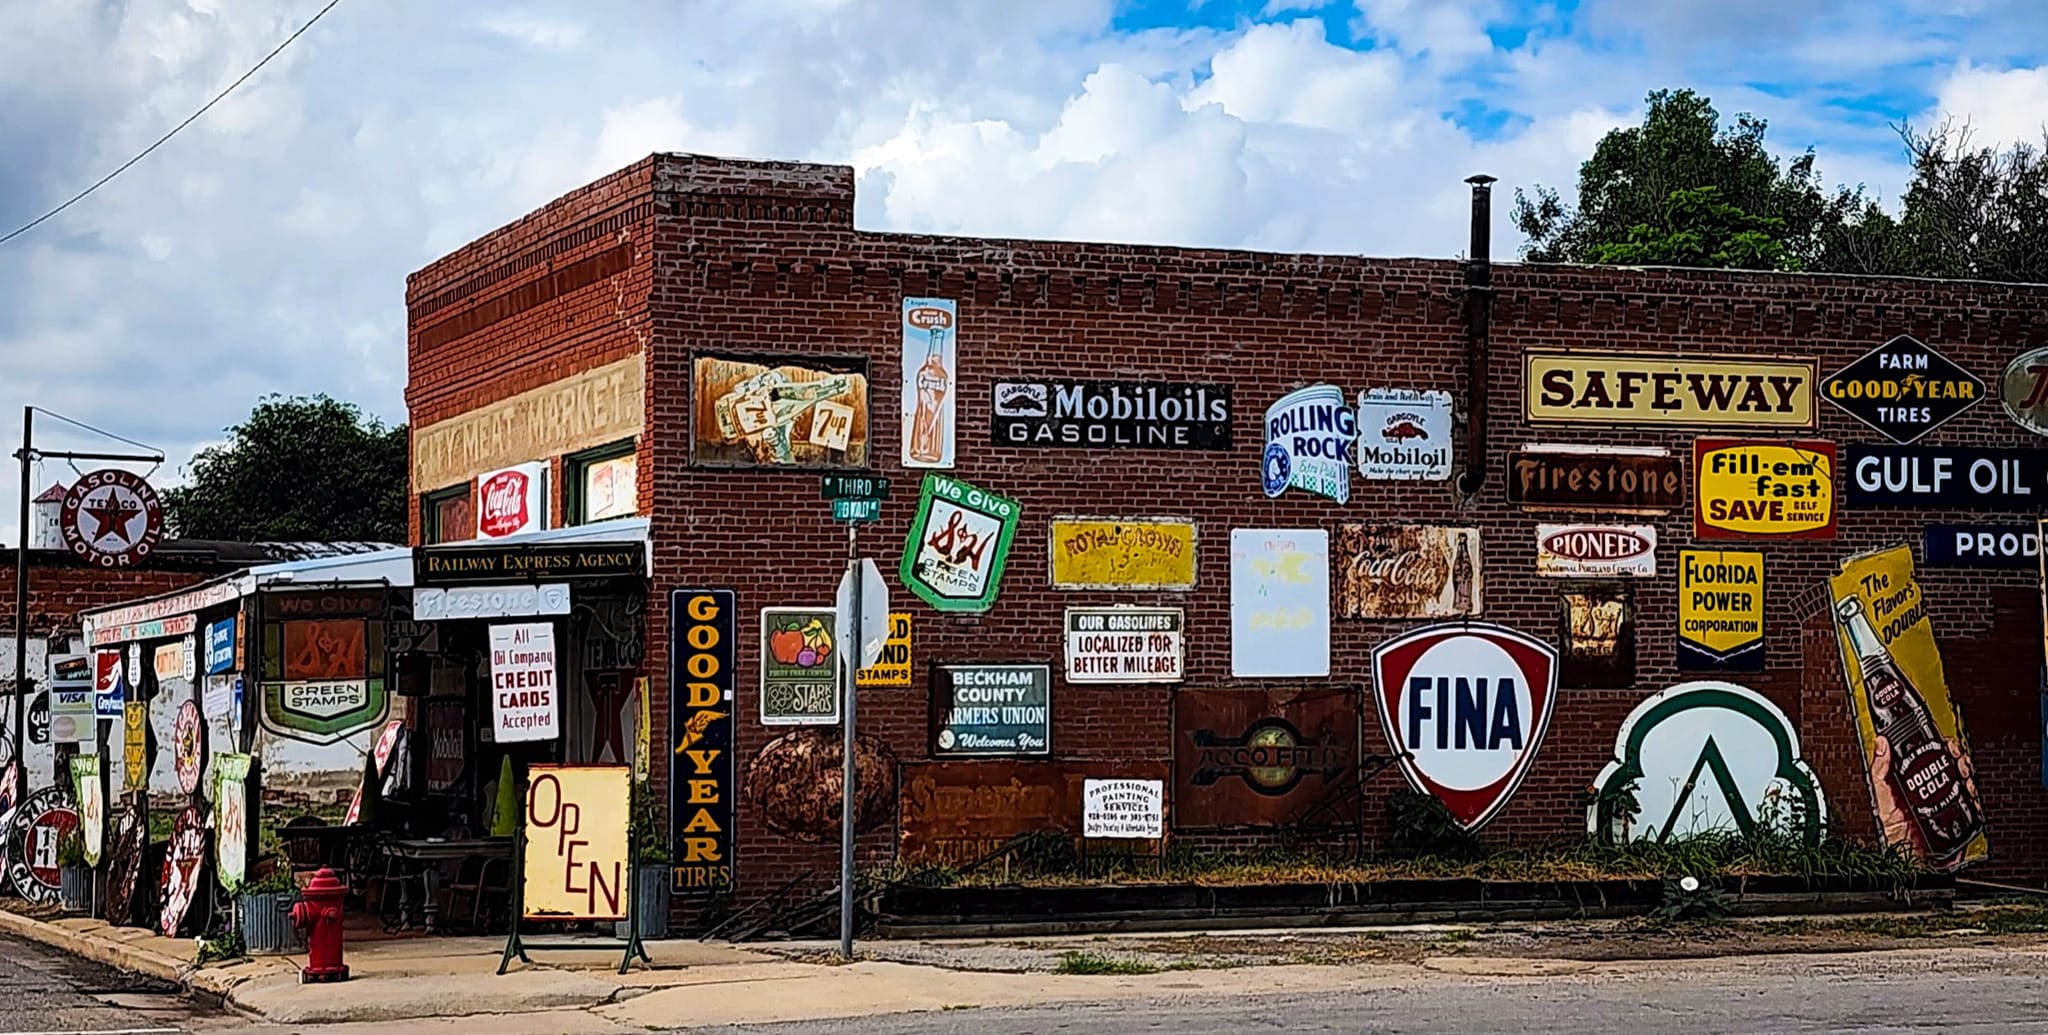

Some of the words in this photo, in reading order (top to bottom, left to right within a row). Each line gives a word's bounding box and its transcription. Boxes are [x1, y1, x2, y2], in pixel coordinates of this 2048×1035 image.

[912, 310, 947, 325] Crush
[1879, 353, 1928, 369] FARM
[1001, 386, 1041, 399] GARGOYLE
[1385, 392, 1398, 401] and
[1541, 369, 1803, 413] SAFEWAY
[1829, 380, 1898, 399] GOOD
[1913, 380, 1975, 399] YEAR
[1054, 384, 1228, 422] Mobiloils
[1270, 404, 1355, 441] ROLLING
[1386, 412, 1426, 426] GARGOYLE
[1877, 407, 1932, 423] TIRES
[416, 429, 458, 472] CITY
[462, 407, 516, 462] MEAT
[1009, 423, 1190, 445] GASOLINE
[1293, 436, 1356, 468] ROCK
[1364, 446, 1447, 467] Mobiloil
[1515, 459, 1679, 495] Firestone
[1855, 456, 1953, 493] GULF
[1969, 458, 2032, 495] OIL
[66, 472, 159, 511] GASOLINE
[838, 477, 873, 496] THIRD
[878, 480, 888, 489] ST
[934, 477, 963, 501] We
[967, 492, 1011, 517] Give
[1710, 498, 1784, 522] SAVE
[1786, 511, 1825, 522] SERVICE
[1793, 501, 1818, 511] SELF
[64, 525, 130, 567] MOTOR
[136, 526, 160, 556] OIL
[1063, 527, 1119, 558] ROYAL
[1552, 532, 1642, 558] PIONEER
[429, 556, 497, 573] RAILWAY
[503, 554, 571, 570] EXPRESS
[576, 553, 635, 568] AGENCY
[923, 558, 981, 584] GREEN
[1685, 555, 1758, 589] FLORIDA
[921, 567, 977, 592] STAMPS
[1860, 573, 1890, 598] The
[279, 597, 314, 613] We
[419, 590, 534, 617] Firestone
[1692, 591, 1752, 612] POWER
[1078, 616, 1104, 630] OUR
[1108, 616, 1172, 630] GASOLINES
[1685, 619, 1759, 633] CORPORATION
[1882, 602, 1927, 645] DOUBLE
[514, 629, 530, 644] All
[1078, 635, 1144, 653] LOCALIZED
[1148, 635, 1172, 652] FOR
[287, 622, 363, 677] S&H
[494, 649, 507, 665] Oil
[509, 648, 553, 670] Company
[686, 596, 722, 708] GOOD
[858, 669, 908, 680] STAMPS
[1073, 656, 1118, 674] BETTER
[1123, 656, 1177, 674] MILEAGE
[495, 669, 553, 688] CREDIT
[953, 671, 1034, 686] BECKHAM
[60, 693, 86, 704] VISA
[291, 685, 360, 696] GREEN
[292, 695, 360, 707] STAMPS
[499, 691, 551, 708] CARDS
[793, 684, 833, 711] STARK
[957, 688, 1026, 702] COUNTY
[1874, 680, 1900, 701] DOUBLE
[1880, 690, 1900, 705] COLA
[503, 710, 552, 731] Accepted
[1001, 706, 1046, 725] UNION
[1408, 676, 1523, 750] FINA
[959, 732, 1017, 747] Welcomes
[1017, 733, 1045, 751] You
[1200, 748, 1268, 766] ACCO
[1906, 755, 1950, 791] DOUBLE
[1089, 782, 1159, 799] PROFESSIONAL
[1918, 771, 1950, 800] COLA
[683, 750, 723, 862] YEAR
[1102, 792, 1150, 803] PAINTING
[1103, 802, 1149, 811] SERVICES
[529, 773, 621, 916] OPEN
[675, 866, 730, 887] TIRES
